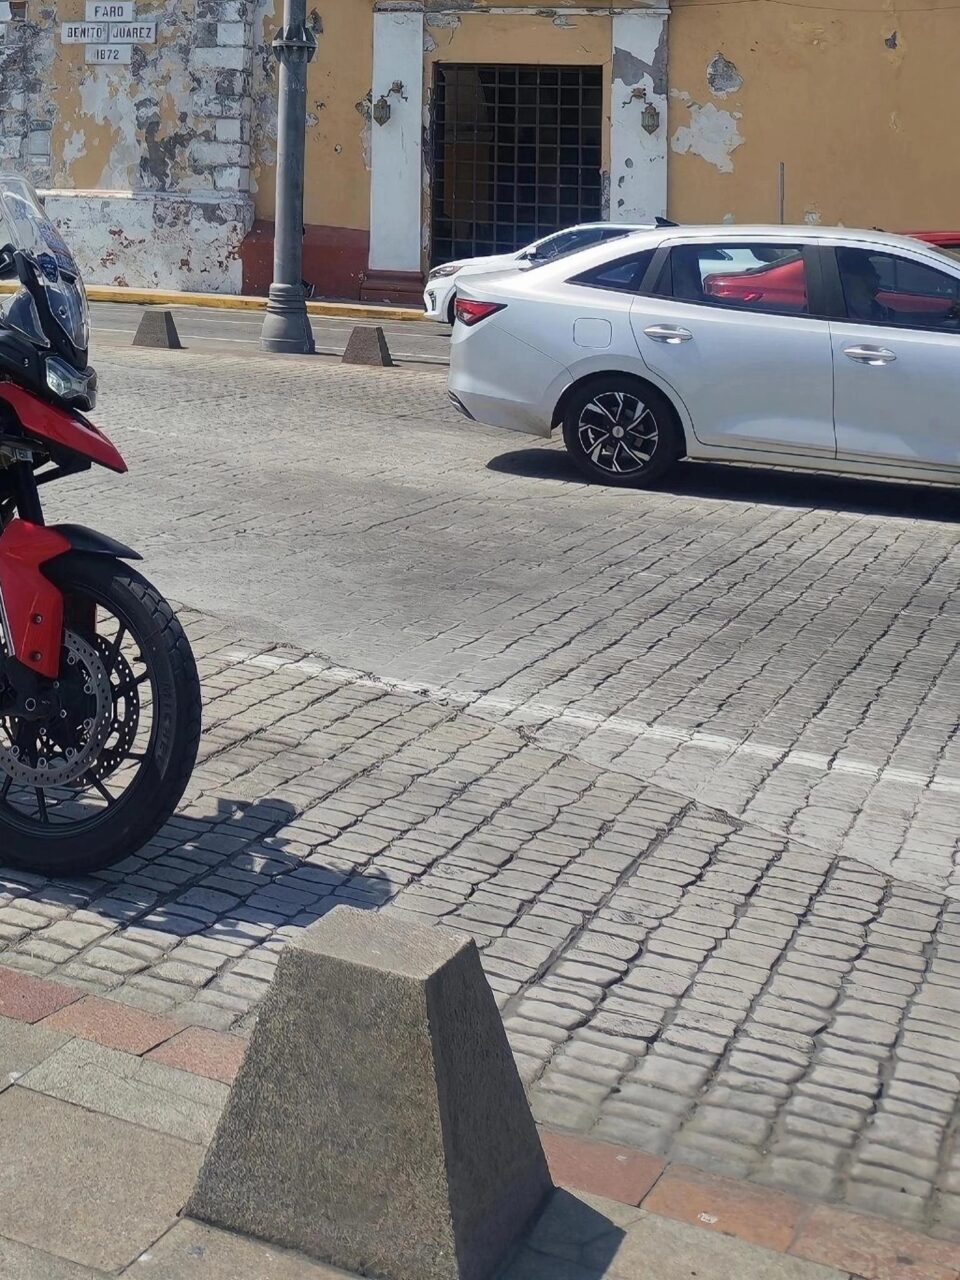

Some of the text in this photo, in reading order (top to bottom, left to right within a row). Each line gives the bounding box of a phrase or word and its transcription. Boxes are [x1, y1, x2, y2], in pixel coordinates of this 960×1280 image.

[94, 6, 124, 17] FARO
[67, 27, 152, 38] BENITO JUAREZ
[96, 49, 120, 60] 1872
